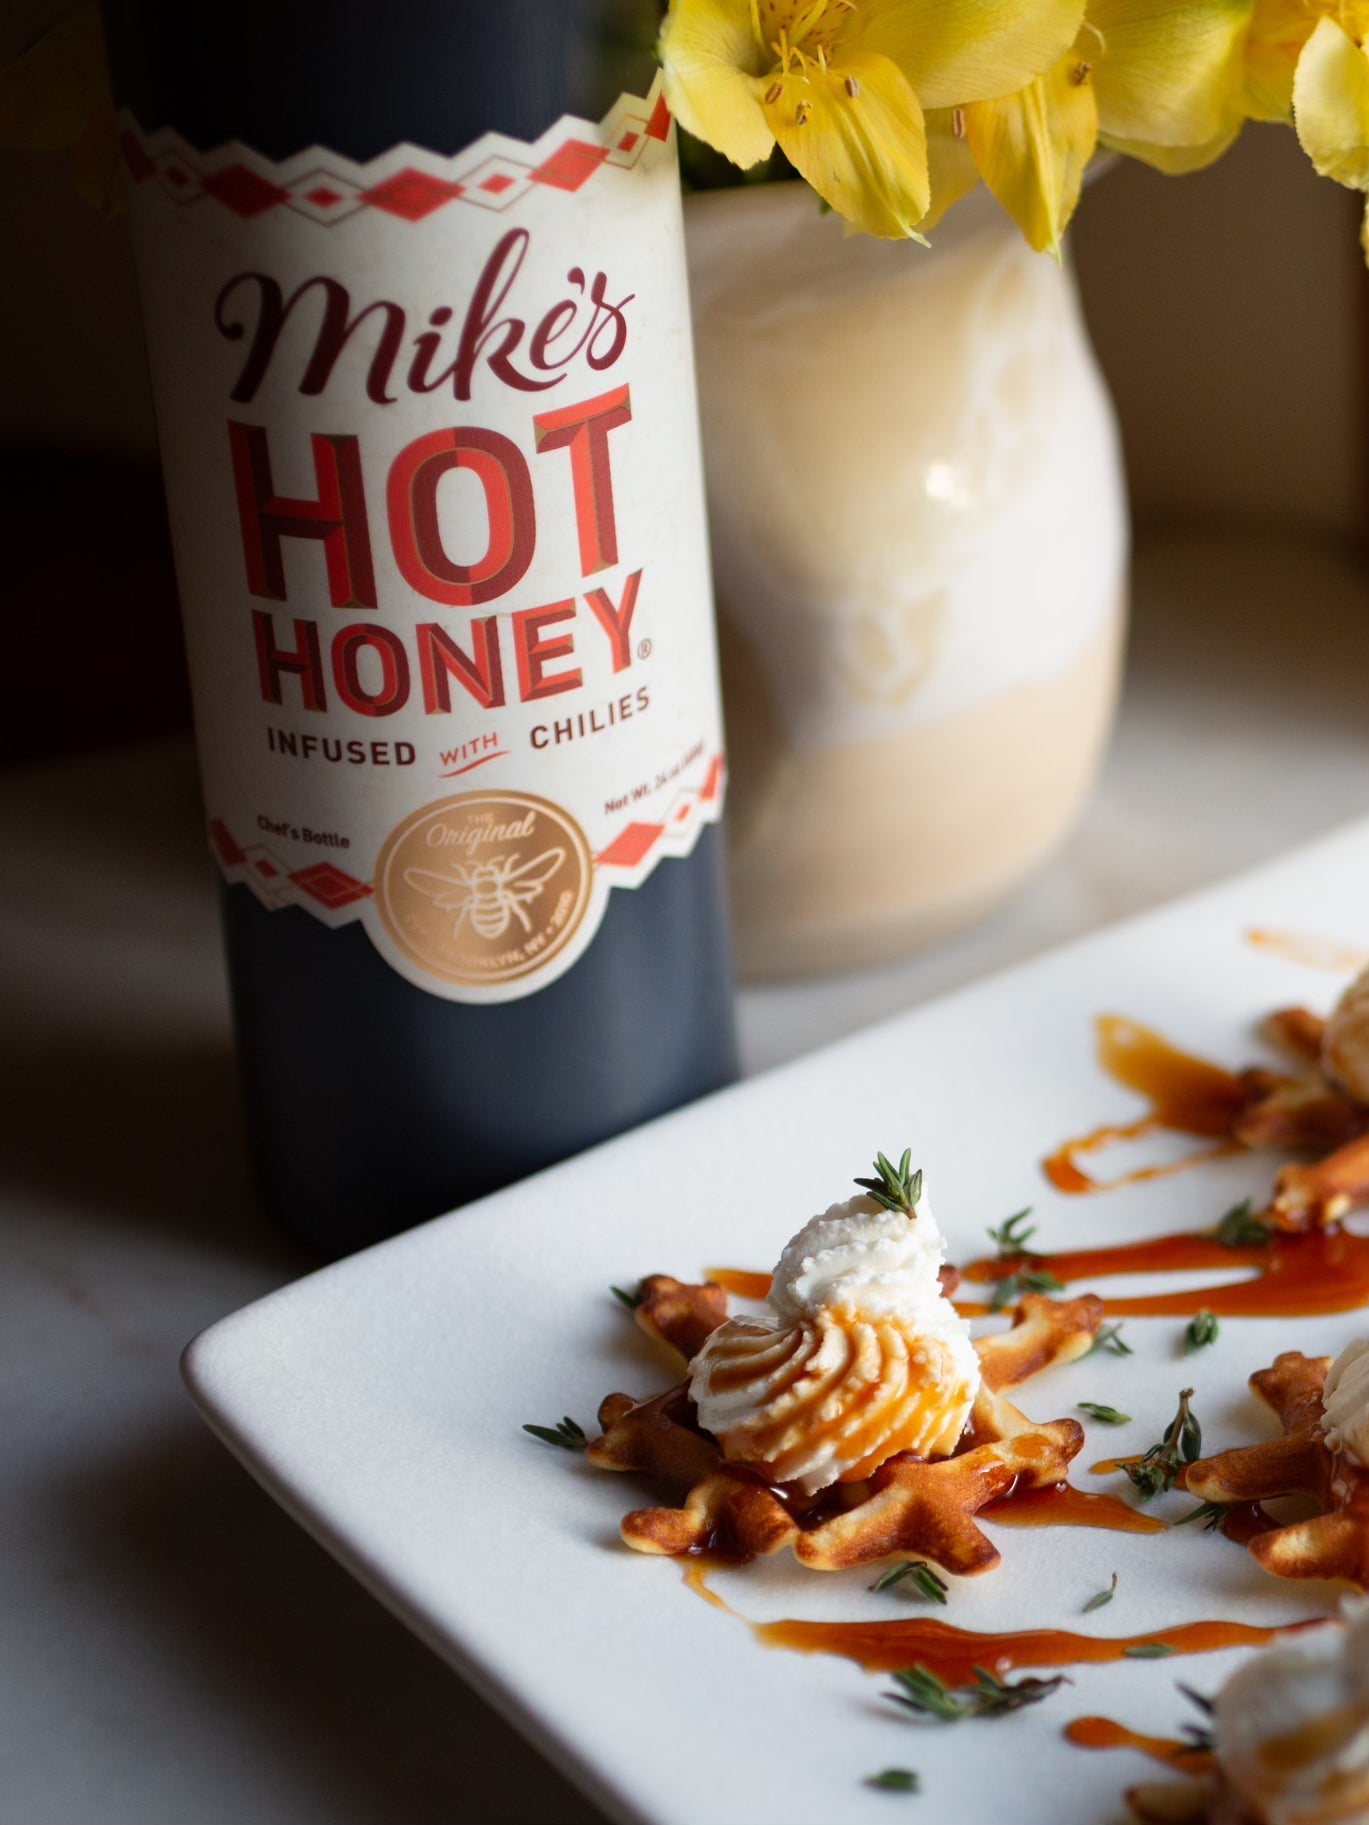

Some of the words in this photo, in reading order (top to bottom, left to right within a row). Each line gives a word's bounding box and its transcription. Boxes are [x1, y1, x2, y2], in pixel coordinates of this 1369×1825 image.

[214, 226, 636, 406] Mike's
[226, 382, 633, 611] HOT
[267, 726, 417, 767] INFUSED
[439, 731, 499, 767] WITH
[529, 685, 651, 751] CHILIES
[256, 813, 300, 841] Chef's
[302, 826, 351, 849] Bottle
[425, 809, 536, 857] Original
[604, 795, 628, 815] Net
